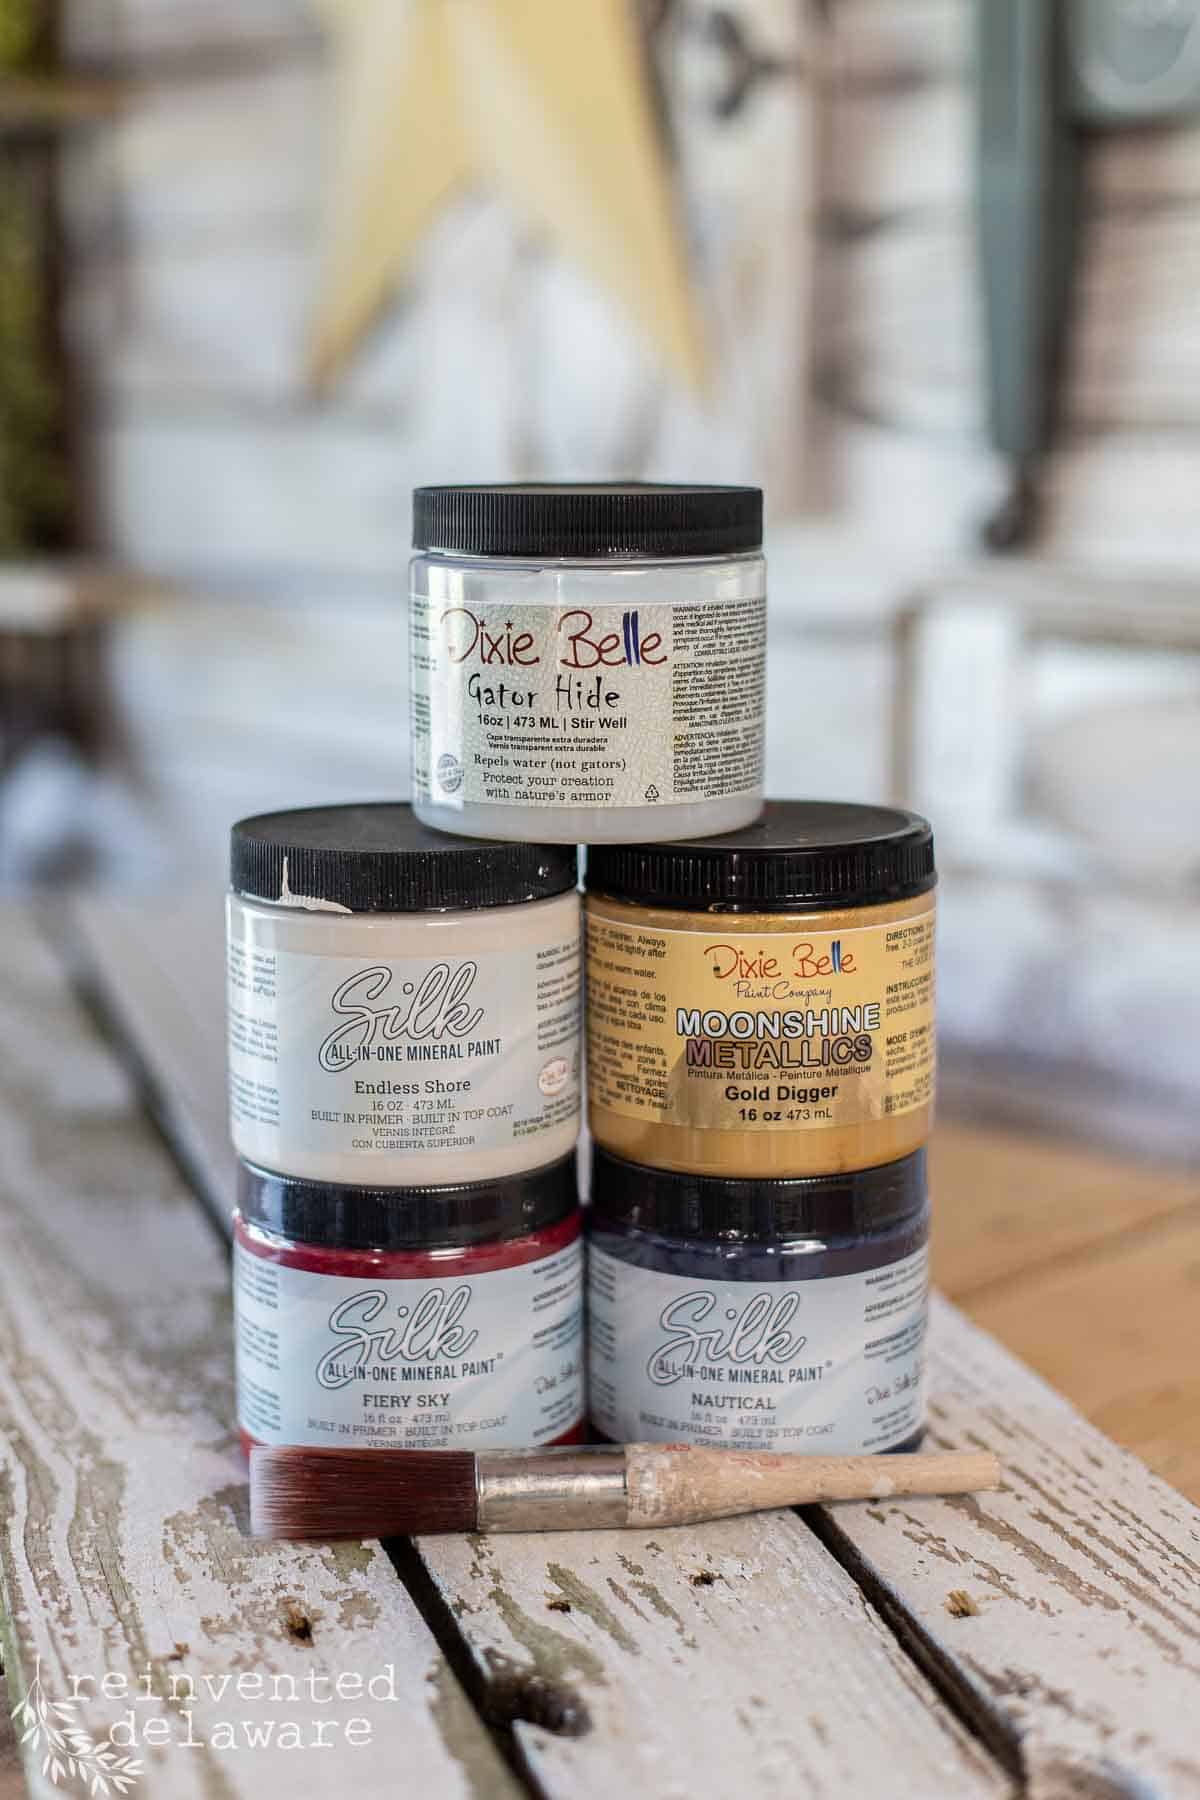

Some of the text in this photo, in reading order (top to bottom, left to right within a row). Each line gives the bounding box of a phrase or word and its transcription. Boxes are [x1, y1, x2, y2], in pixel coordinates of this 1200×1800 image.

[441, 607, 668, 668] Dixie Belle
[468, 673, 620, 711] Gator Hide
[477, 714, 504, 728] 16oz
[513, 716, 536, 728] 473
[539, 717, 559, 729] ML
[571, 717, 595, 729] Stir
[598, 717, 628, 729] Well
[474, 753, 627, 773] Repels water (not gators)
[483, 772, 615, 787] Protect your creation
[486, 788, 612, 801] with nature's armor
[638, 935, 666, 948] Always
[704, 940, 858, 979] Dixie Belle
[733, 981, 832, 1007] Paint Company
[319, 961, 484, 1073] Silk
[675, 1002, 881, 1040] MOONSHINE
[330, 1039, 502, 1062] ALL-IN-ONE MINERAL PAINT
[685, 1034, 873, 1070] METALLICS
[687, 1068, 723, 1080] Pintura
[726, 1068, 770, 1081] Metálica
[780, 1069, 823, 1080] Peinture
[355, 1078, 471, 1095] Endless Shore
[725, 1085, 838, 1106] Gold Digger
[311, 1104, 514, 1125] BUILT IN PRIMER BUILT IN TOP COAT
[371, 1100, 384, 1111] 16
[387, 1100, 403, 1112] OZ
[413, 1099, 434, 1111] 473
[738, 1107, 833, 1122] 16 oz 473 mL
[352, 1135, 476, 1150] CON CUBIERTA SUPERIOR
[372, 1127, 410, 1137] VERNIS
[315, 1285, 478, 1389] Silk
[648, 1290, 806, 1386] Silk
[327, 1358, 495, 1382] ALL-IN-ONE MINERAL PAINT
[658, 1360, 823, 1384] ALL-IN-ONE MINERAL PAINT
[363, 1393, 451, 1408] FIERY SKY
[691, 1393, 776, 1410] NAUTICAL
[338, 1421, 350, 1433] IN
[352, 1424, 397, 1436] PRIMER
[405, 1425, 438, 1437] BUILT
[441, 1424, 453, 1435] IN
[456, 1421, 478, 1433] TOP
[480, 1416, 507, 1430] COAT
[412, 1413, 432, 1424] 473
